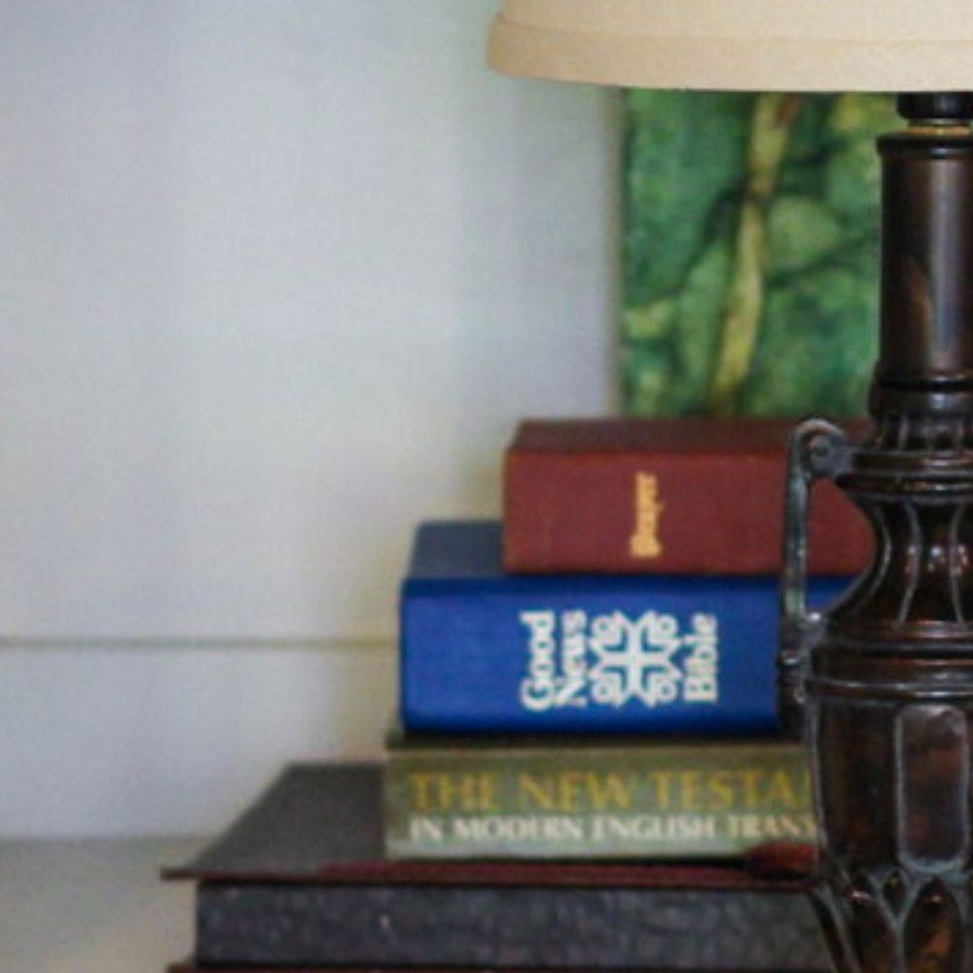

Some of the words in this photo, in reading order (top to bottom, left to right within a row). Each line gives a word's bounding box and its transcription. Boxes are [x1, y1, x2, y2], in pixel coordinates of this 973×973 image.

[519, 610, 555, 710] Good
[556, 610, 588, 707] News
[683, 612, 719, 703] Bible
[410, 816, 443, 842] IN
[454, 814, 583, 841] MODERN
[590, 813, 716, 840] ENGLISH
[411, 772, 499, 810] THE
[516, 772, 633, 810] NEW
[651, 770, 811, 810] TESTA
